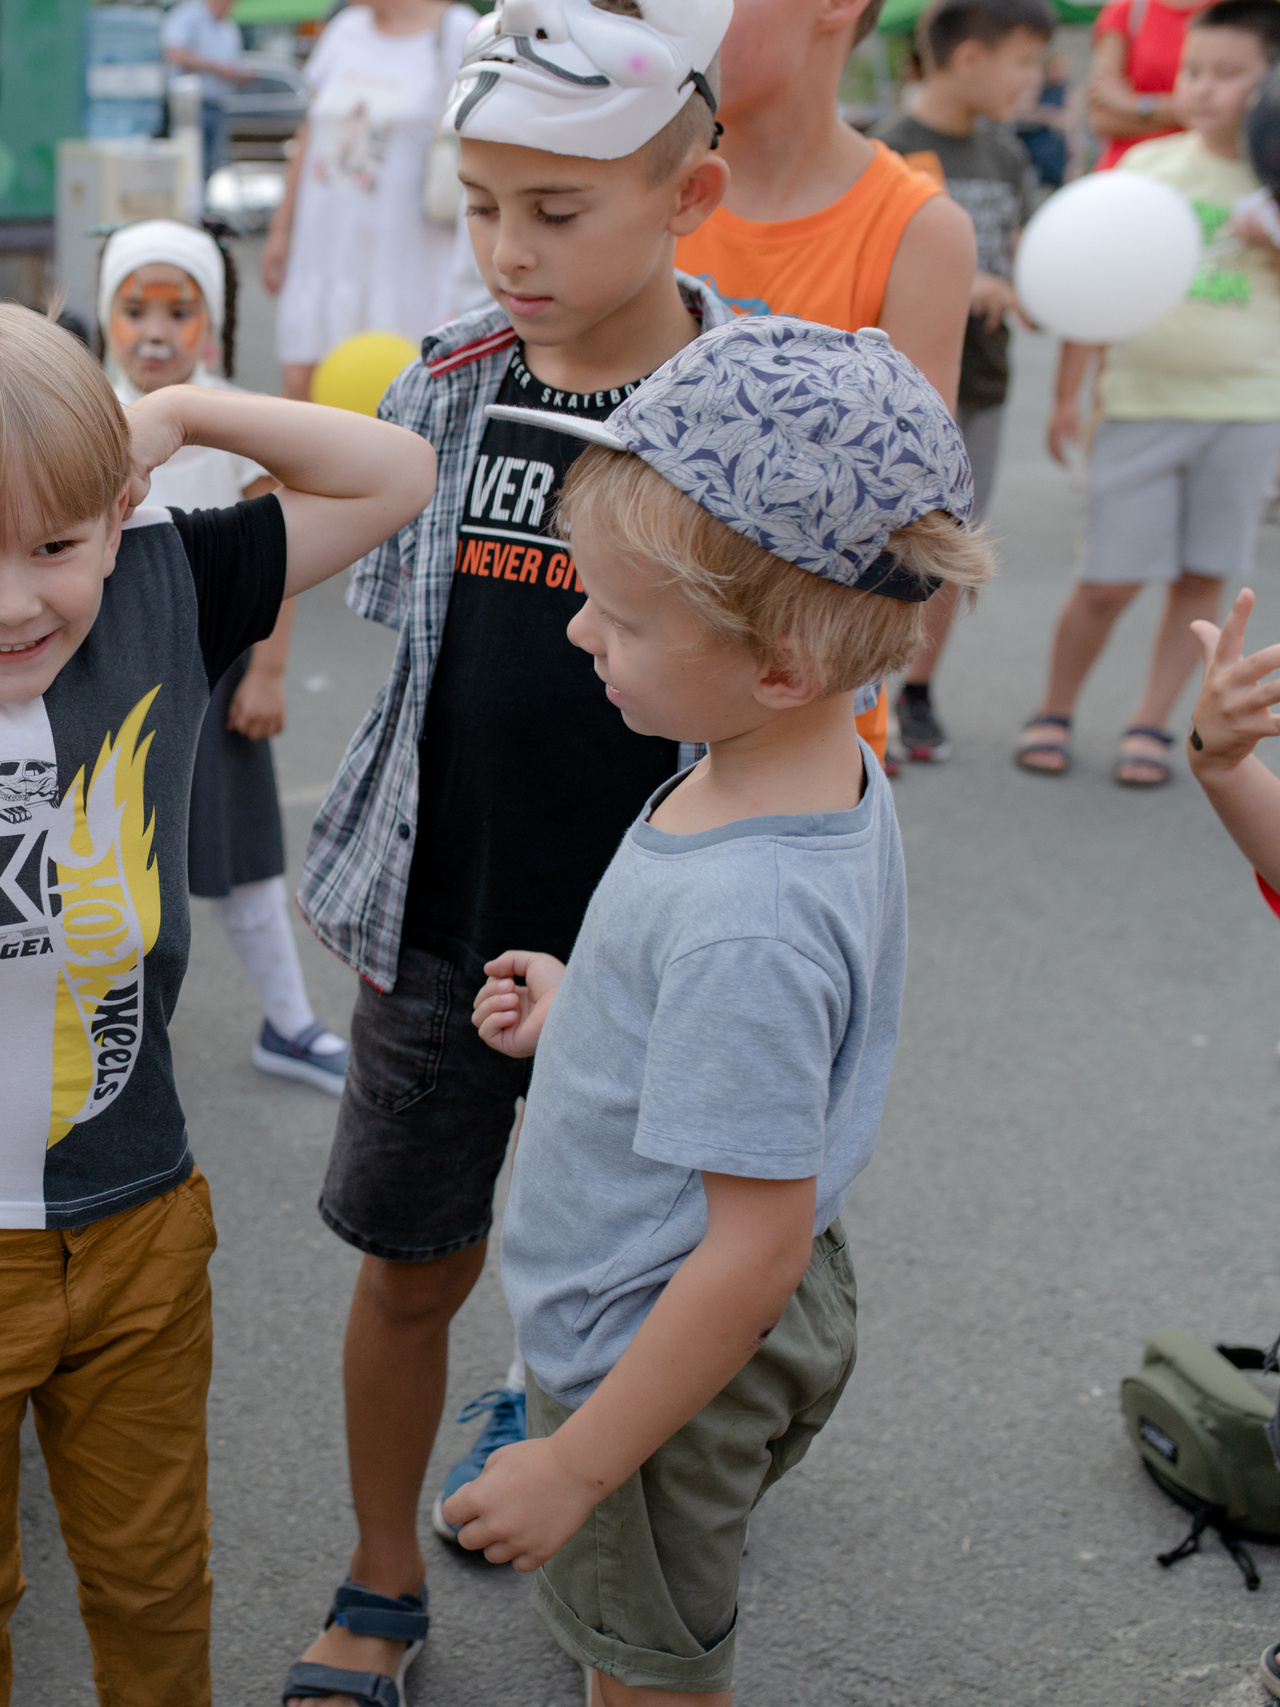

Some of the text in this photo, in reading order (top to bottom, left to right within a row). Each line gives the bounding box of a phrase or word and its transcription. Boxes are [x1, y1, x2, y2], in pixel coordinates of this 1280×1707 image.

[510, 346, 531, 389] VER
[470, 454, 555, 527] VER
[461, 539, 543, 584] NEVER
